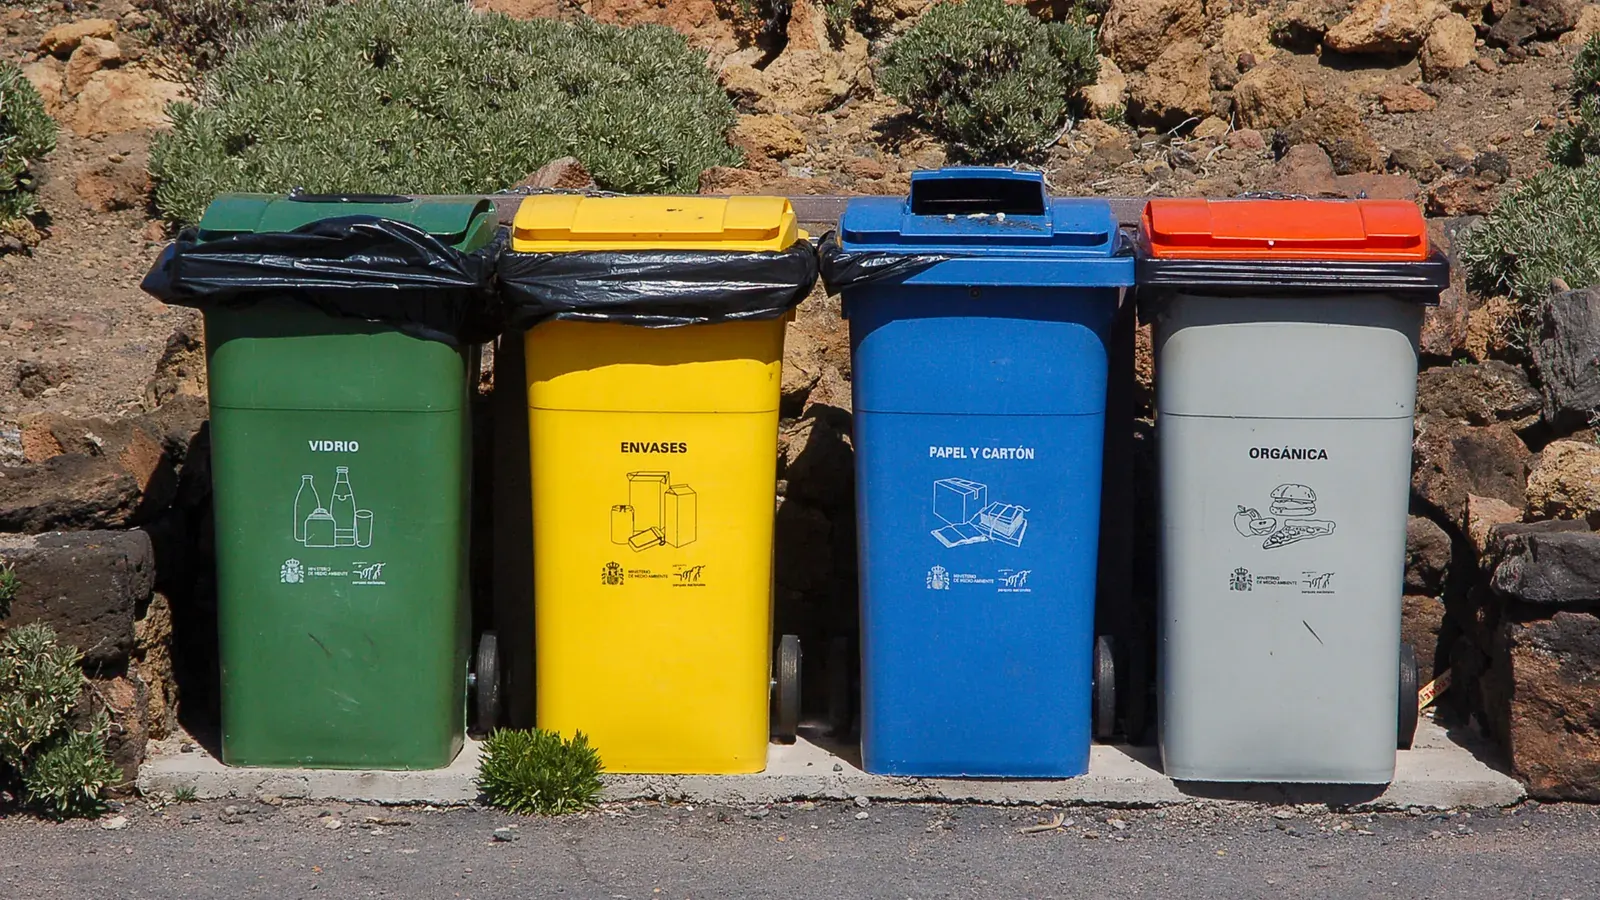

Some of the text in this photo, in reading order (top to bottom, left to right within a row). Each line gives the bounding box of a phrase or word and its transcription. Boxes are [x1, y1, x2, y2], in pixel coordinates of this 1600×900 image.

[308, 440, 360, 453] VIDRIO
[620, 441, 688, 454] ENVASES
[929, 445, 1035, 460] PAPEL Y CARTÓN
[1249, 445, 1328, 460] ORGÁNICA
